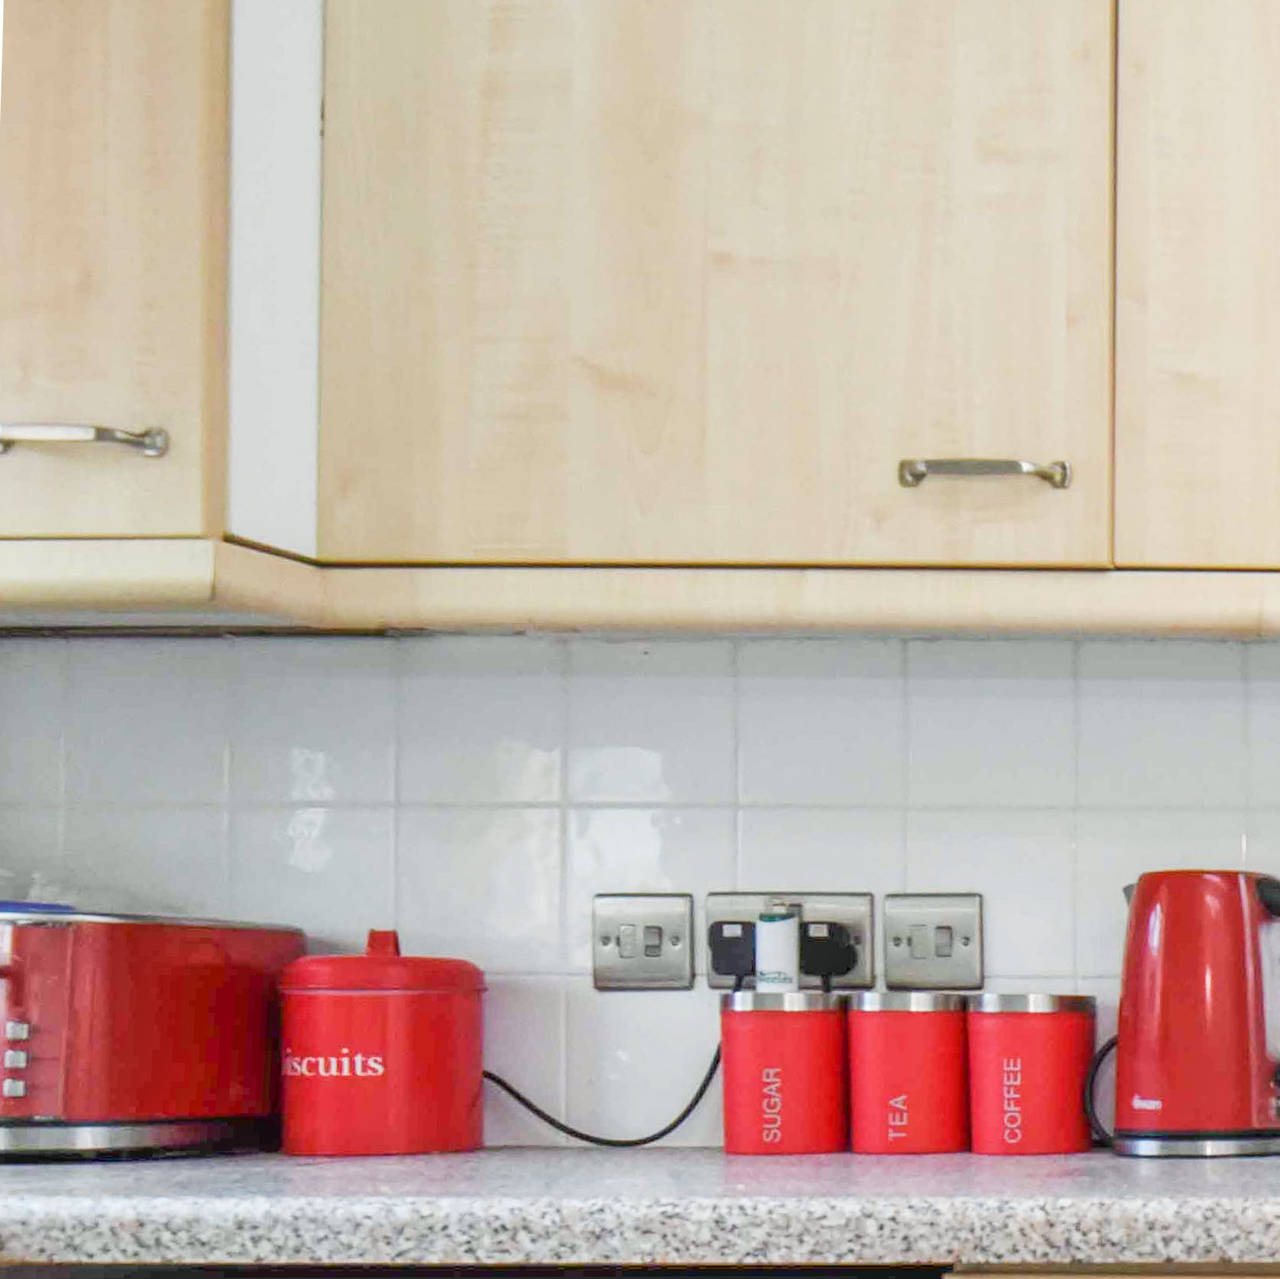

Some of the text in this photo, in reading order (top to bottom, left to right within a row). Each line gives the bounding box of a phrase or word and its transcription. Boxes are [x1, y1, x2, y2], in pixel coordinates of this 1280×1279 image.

[282, 1047, 384, 1077] iscuits
[762, 1068, 782, 1144] SUGAR
[889, 1095, 908, 1140] TEA
[1003, 1058, 1023, 1144] COFFEE
